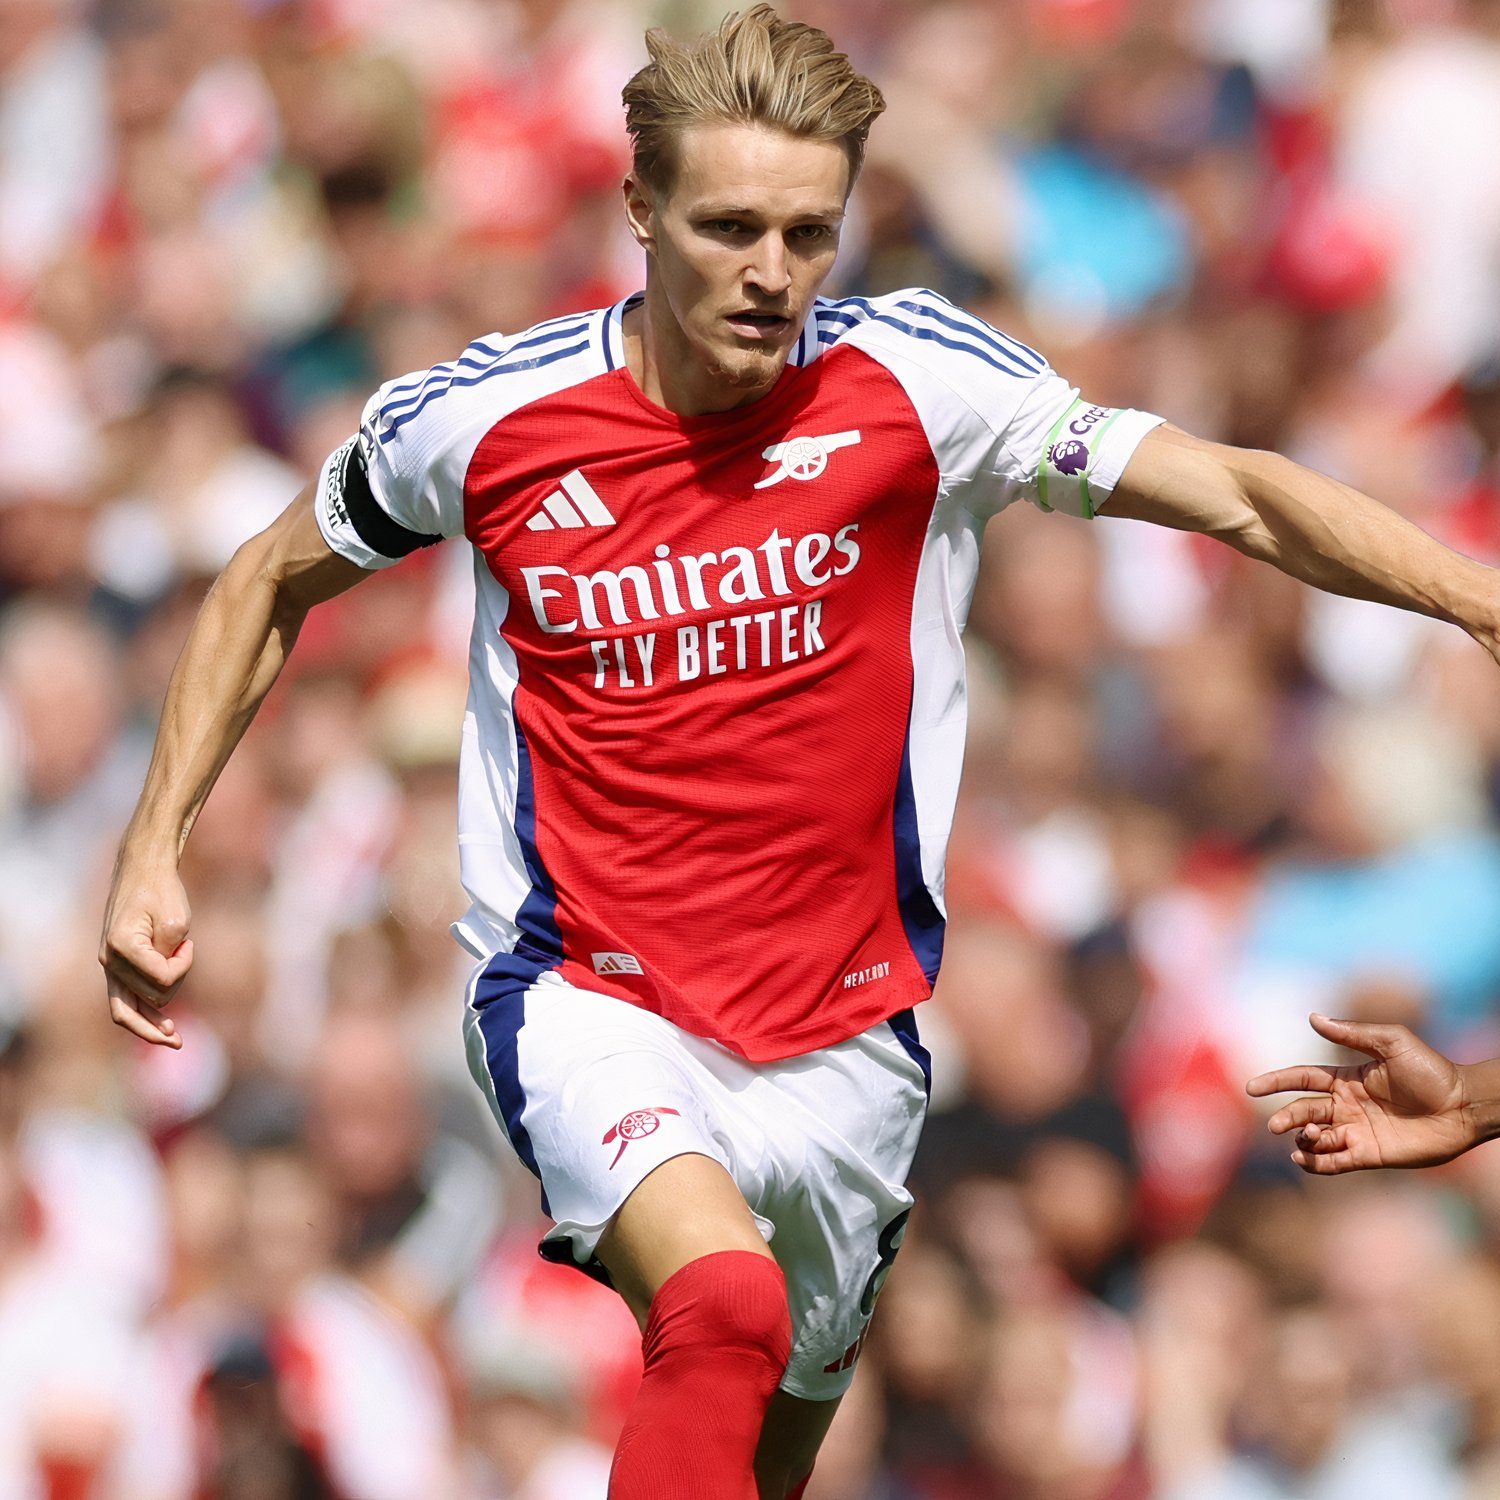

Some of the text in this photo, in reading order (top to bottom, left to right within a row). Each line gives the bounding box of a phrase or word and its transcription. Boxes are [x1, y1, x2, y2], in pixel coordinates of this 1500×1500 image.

[1069, 406, 1109, 435] Cap
[519, 523, 861, 634] Emirates
[590, 600, 826, 689] FLY BETTER
[844, 961, 889, 988] HEAT.RDY
